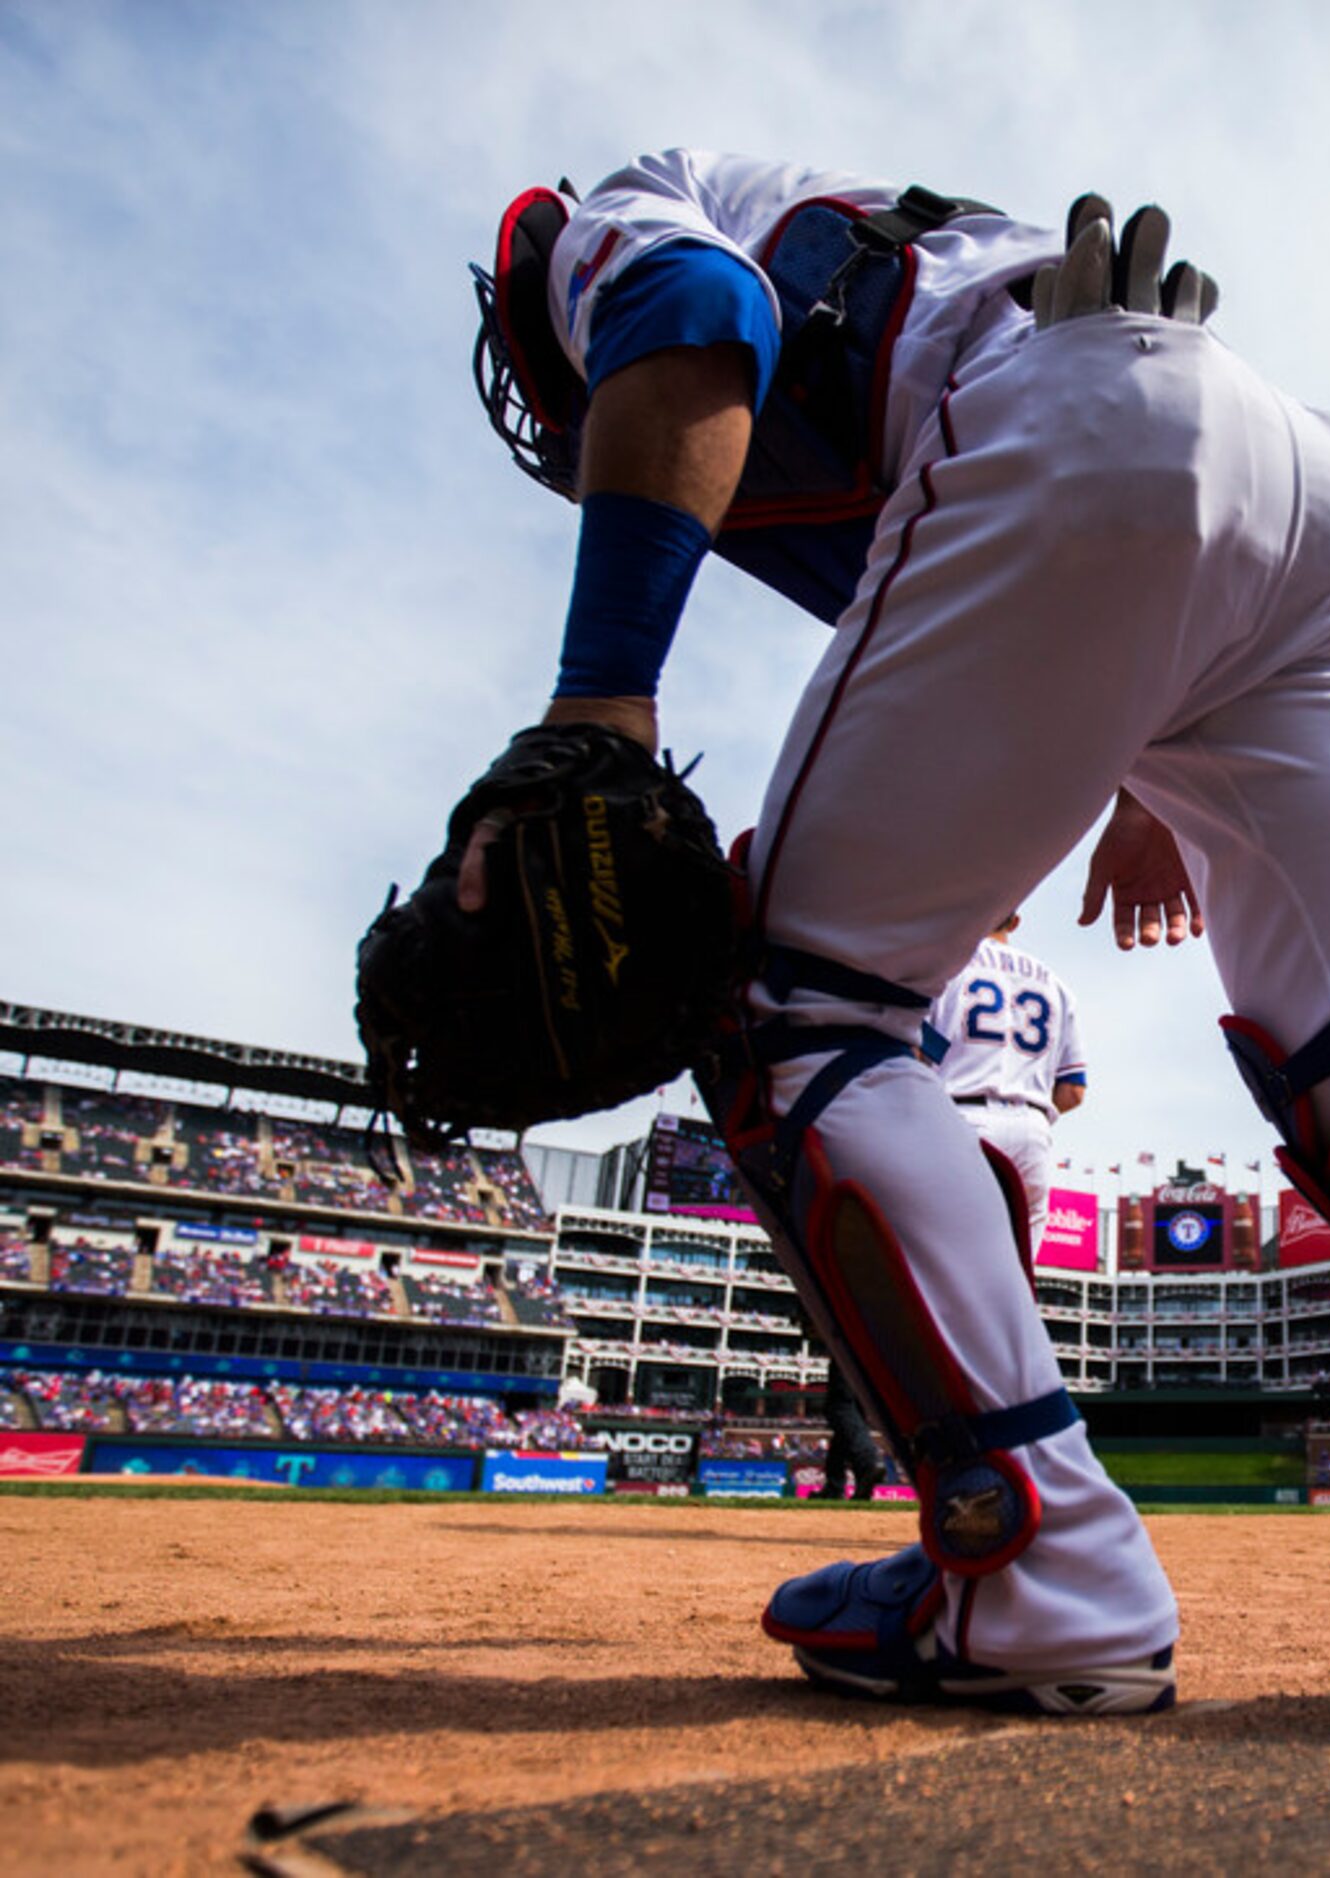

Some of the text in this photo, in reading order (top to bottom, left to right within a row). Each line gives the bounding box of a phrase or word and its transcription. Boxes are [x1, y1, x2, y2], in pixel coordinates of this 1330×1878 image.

[964, 977, 1053, 1056] 23
[599, 1431, 693, 1452] NOCO
[492, 1472, 584, 1492] Southwest
